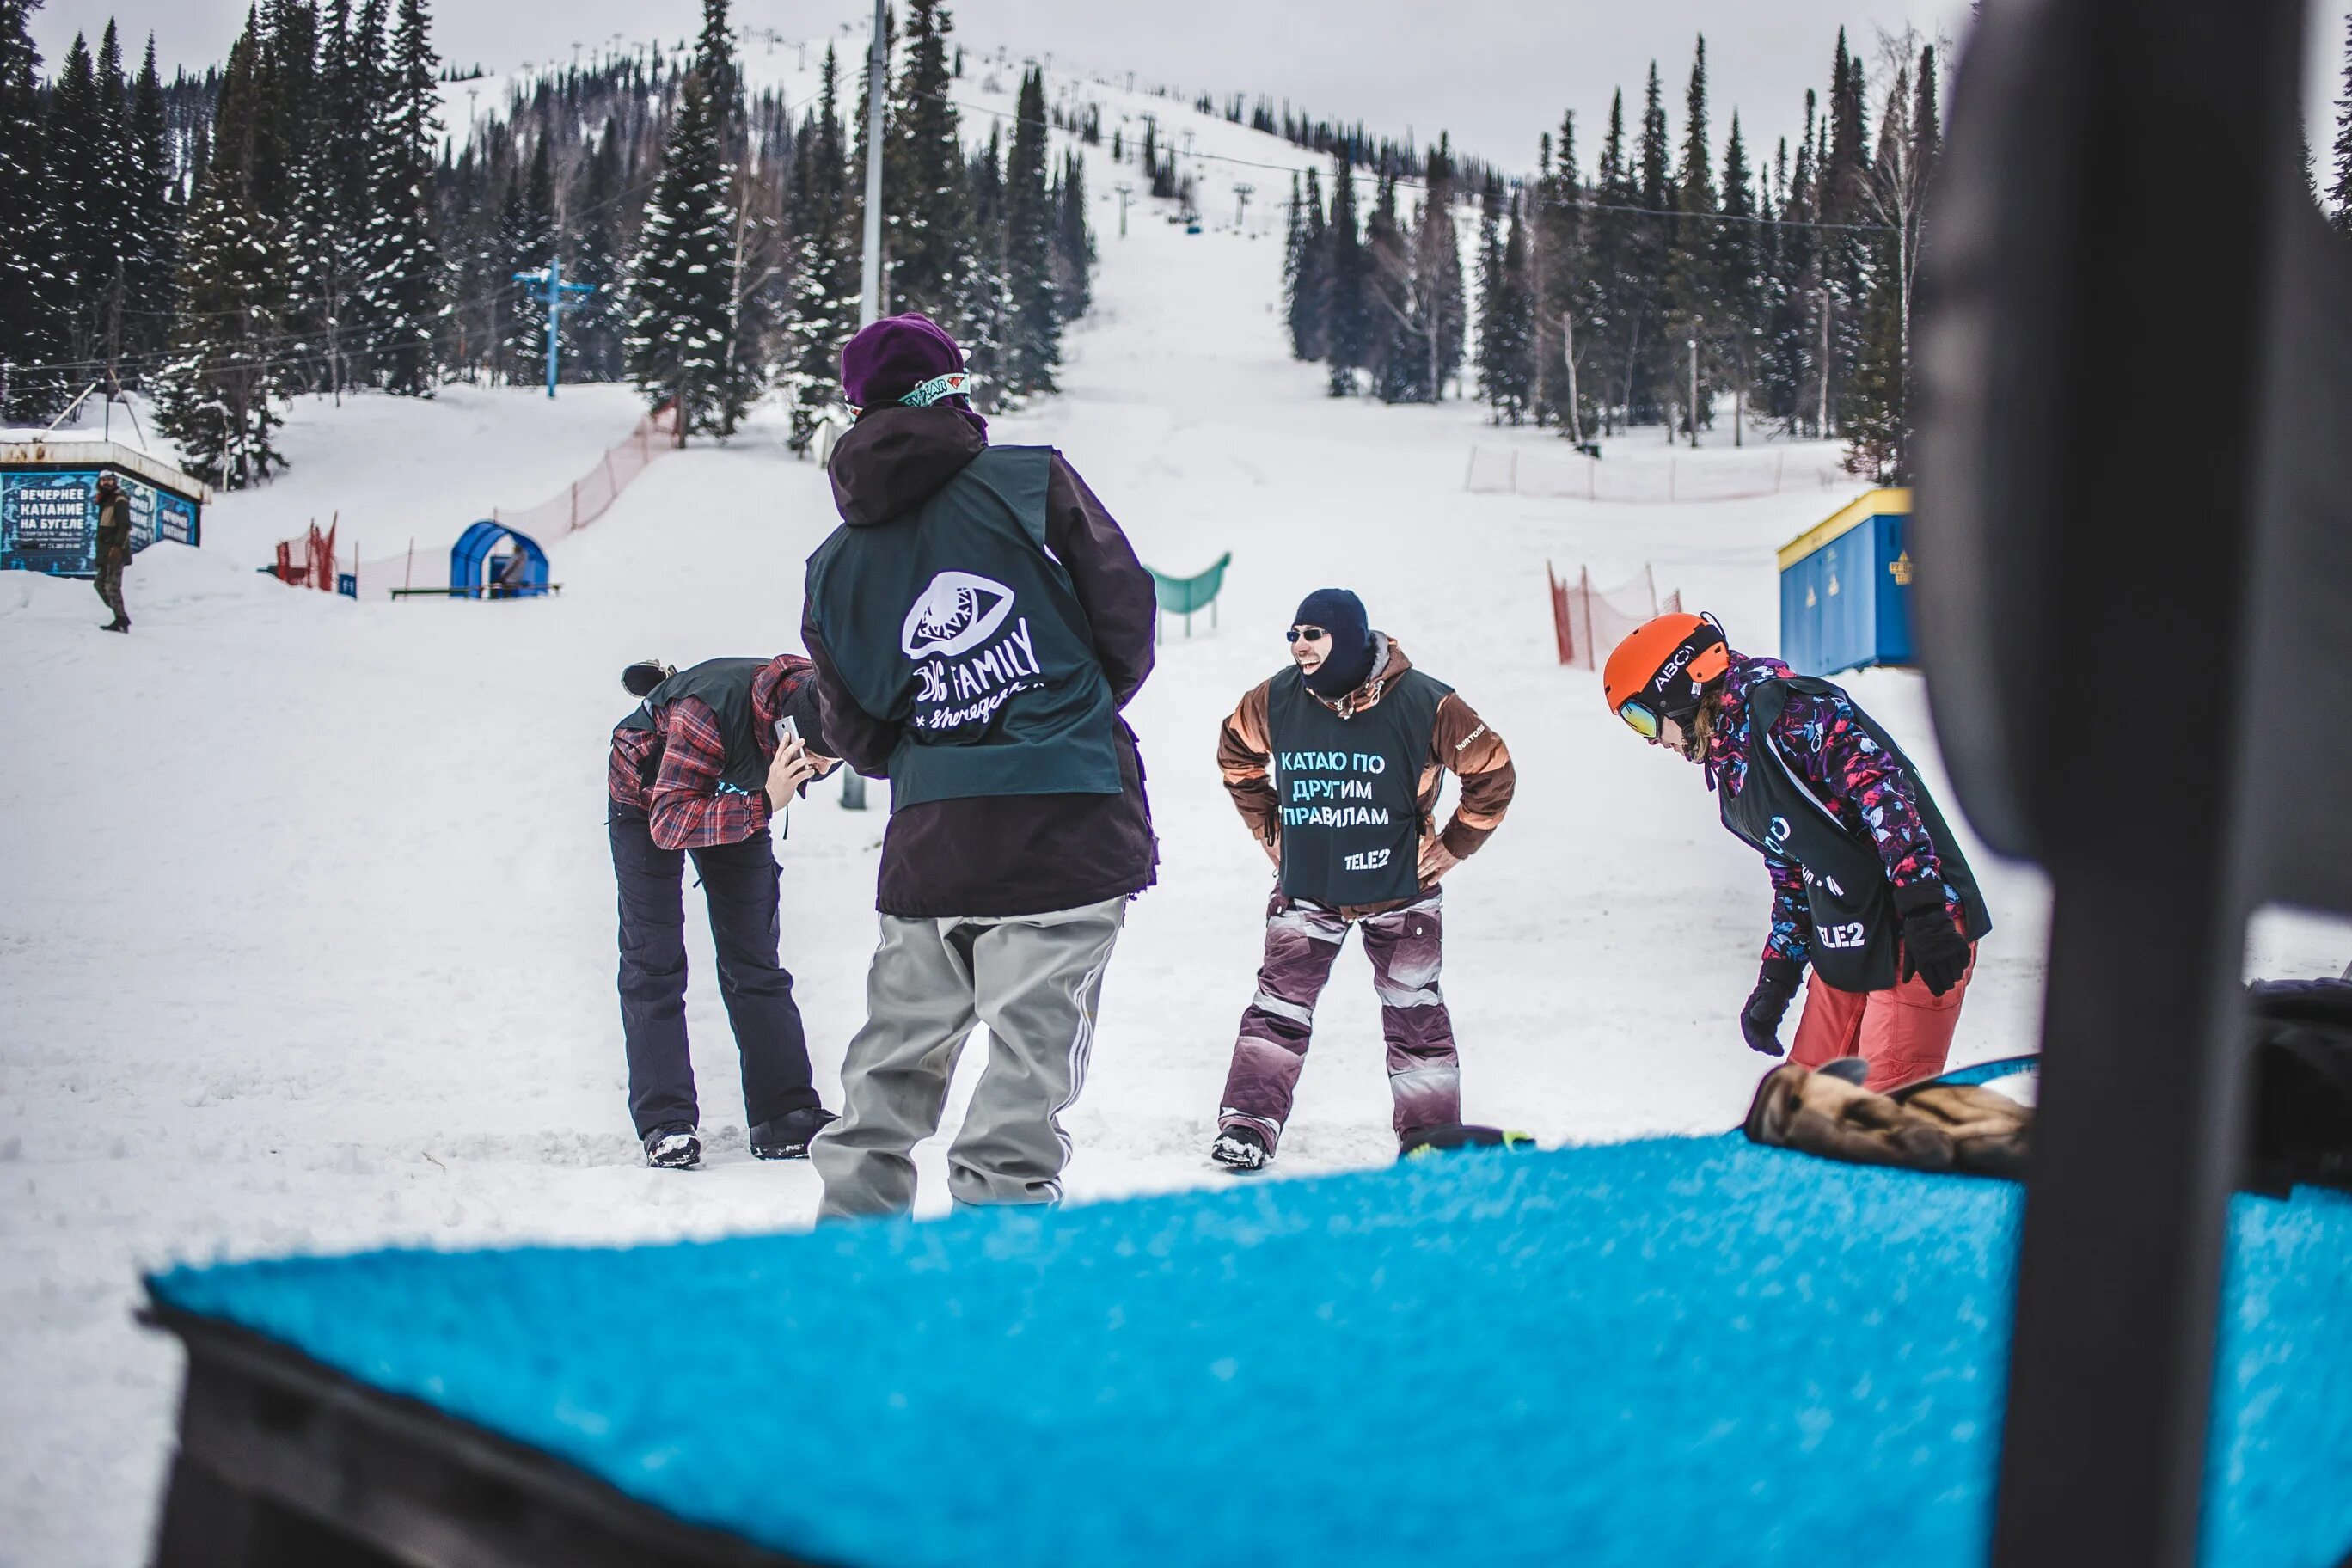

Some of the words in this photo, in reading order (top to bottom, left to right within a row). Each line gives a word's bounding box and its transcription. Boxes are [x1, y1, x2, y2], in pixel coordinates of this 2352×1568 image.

[20, 488, 84, 500] ВЕЧЕРНЕЕ
[20, 503, 84, 516] КАТАНИЕ
[20, 518, 37, 529] НА
[40, 518, 84, 530] БУГЕЛЕ
[1281, 751, 1348, 771] КАТАЮ
[1352, 753, 1386, 775] ПО
[1292, 779, 1373, 802] ДРУГИМ
[1283, 806, 1389, 828] ПРАВИЛАМ
[1344, 848, 1391, 871] TELE2
